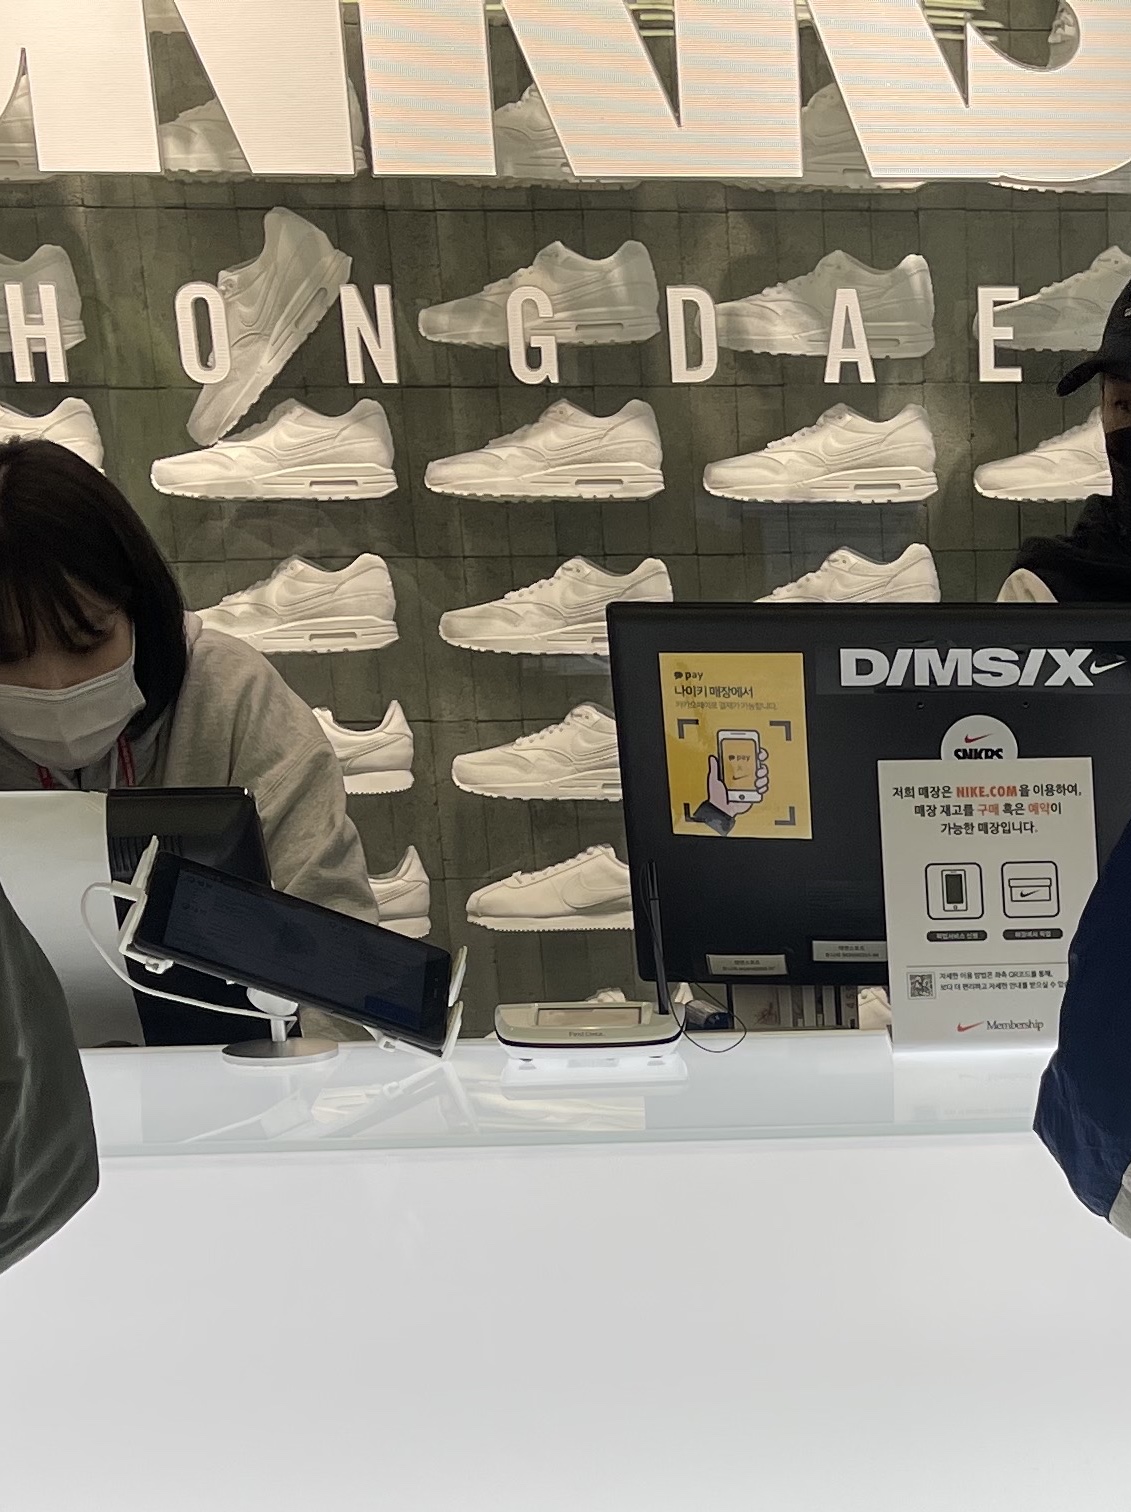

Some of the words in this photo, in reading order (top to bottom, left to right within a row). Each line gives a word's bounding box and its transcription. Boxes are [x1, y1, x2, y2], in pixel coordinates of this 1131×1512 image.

[4, 281, 1024, 384] HONGDAE
[685, 671, 704, 681] pay
[675, 685, 707, 698] 나이키
[709, 685, 754, 698] 매장에서
[892, 786, 915, 799] 저희
[918, 785, 953, 799] 매장은
[1033, 783, 1082, 797] 이용하여,
[914, 804, 937, 817] 매장
[940, 803, 974, 817] 재고를
[977, 803, 1000, 816] 구매
[1002, 802, 1025, 816] 혹은
[1028, 802, 1062, 816] 예약이
[940, 822, 975, 835] 가능한
[978, 821, 1038, 835] 매장입니다.
[986, 1019, 1044, 1031] Membership
